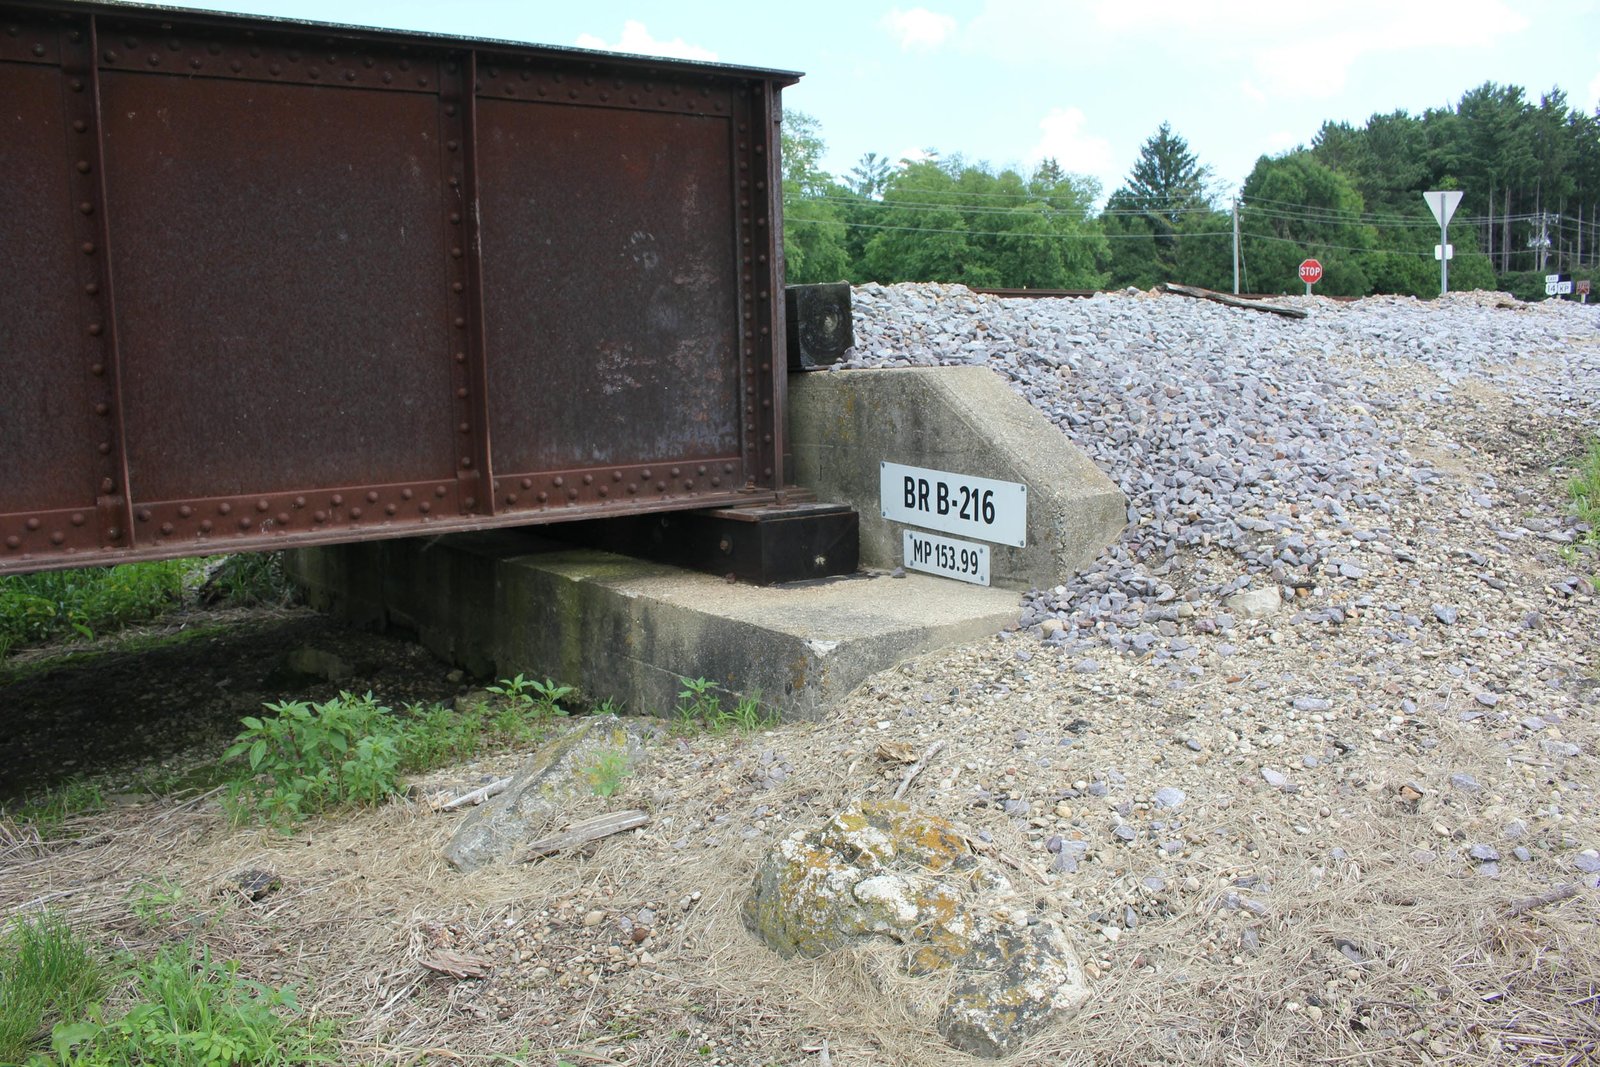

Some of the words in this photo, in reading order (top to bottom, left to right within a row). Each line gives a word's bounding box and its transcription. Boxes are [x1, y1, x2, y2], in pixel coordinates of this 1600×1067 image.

[1300, 266, 1321, 276] STOP
[1547, 285, 1556, 293] 14
[904, 476, 930, 512] BR
[937, 481, 996, 525] B-216
[913, 539, 932, 564] MP
[935, 543, 979, 575] 153.99
